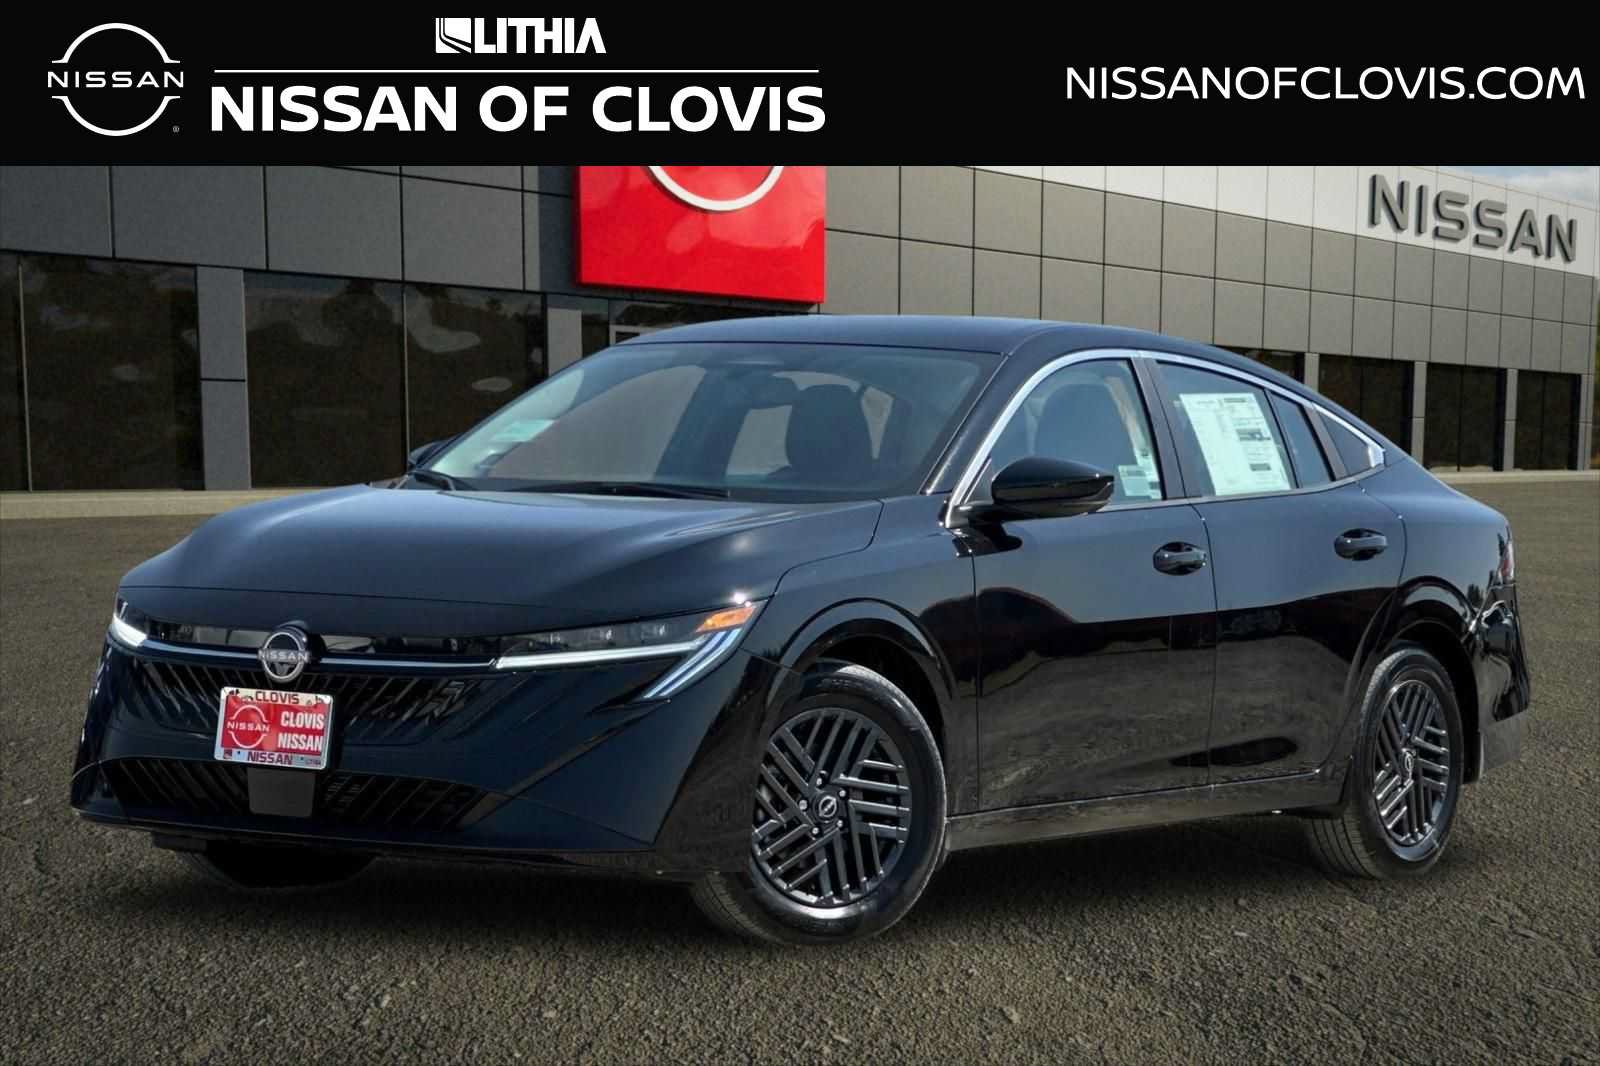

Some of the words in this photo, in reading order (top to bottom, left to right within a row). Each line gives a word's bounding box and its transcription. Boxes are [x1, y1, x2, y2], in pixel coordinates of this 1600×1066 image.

[1369, 173, 1578, 263] NISSAN
[258, 650, 308, 663] NISSAN
[255, 690, 300, 705] CLOVIS
[226, 721, 270, 733] NISSAN
[280, 711, 325, 729] CLOVIS
[277, 732, 324, 751] NISSAN
[247, 751, 293, 766] NISSAN
